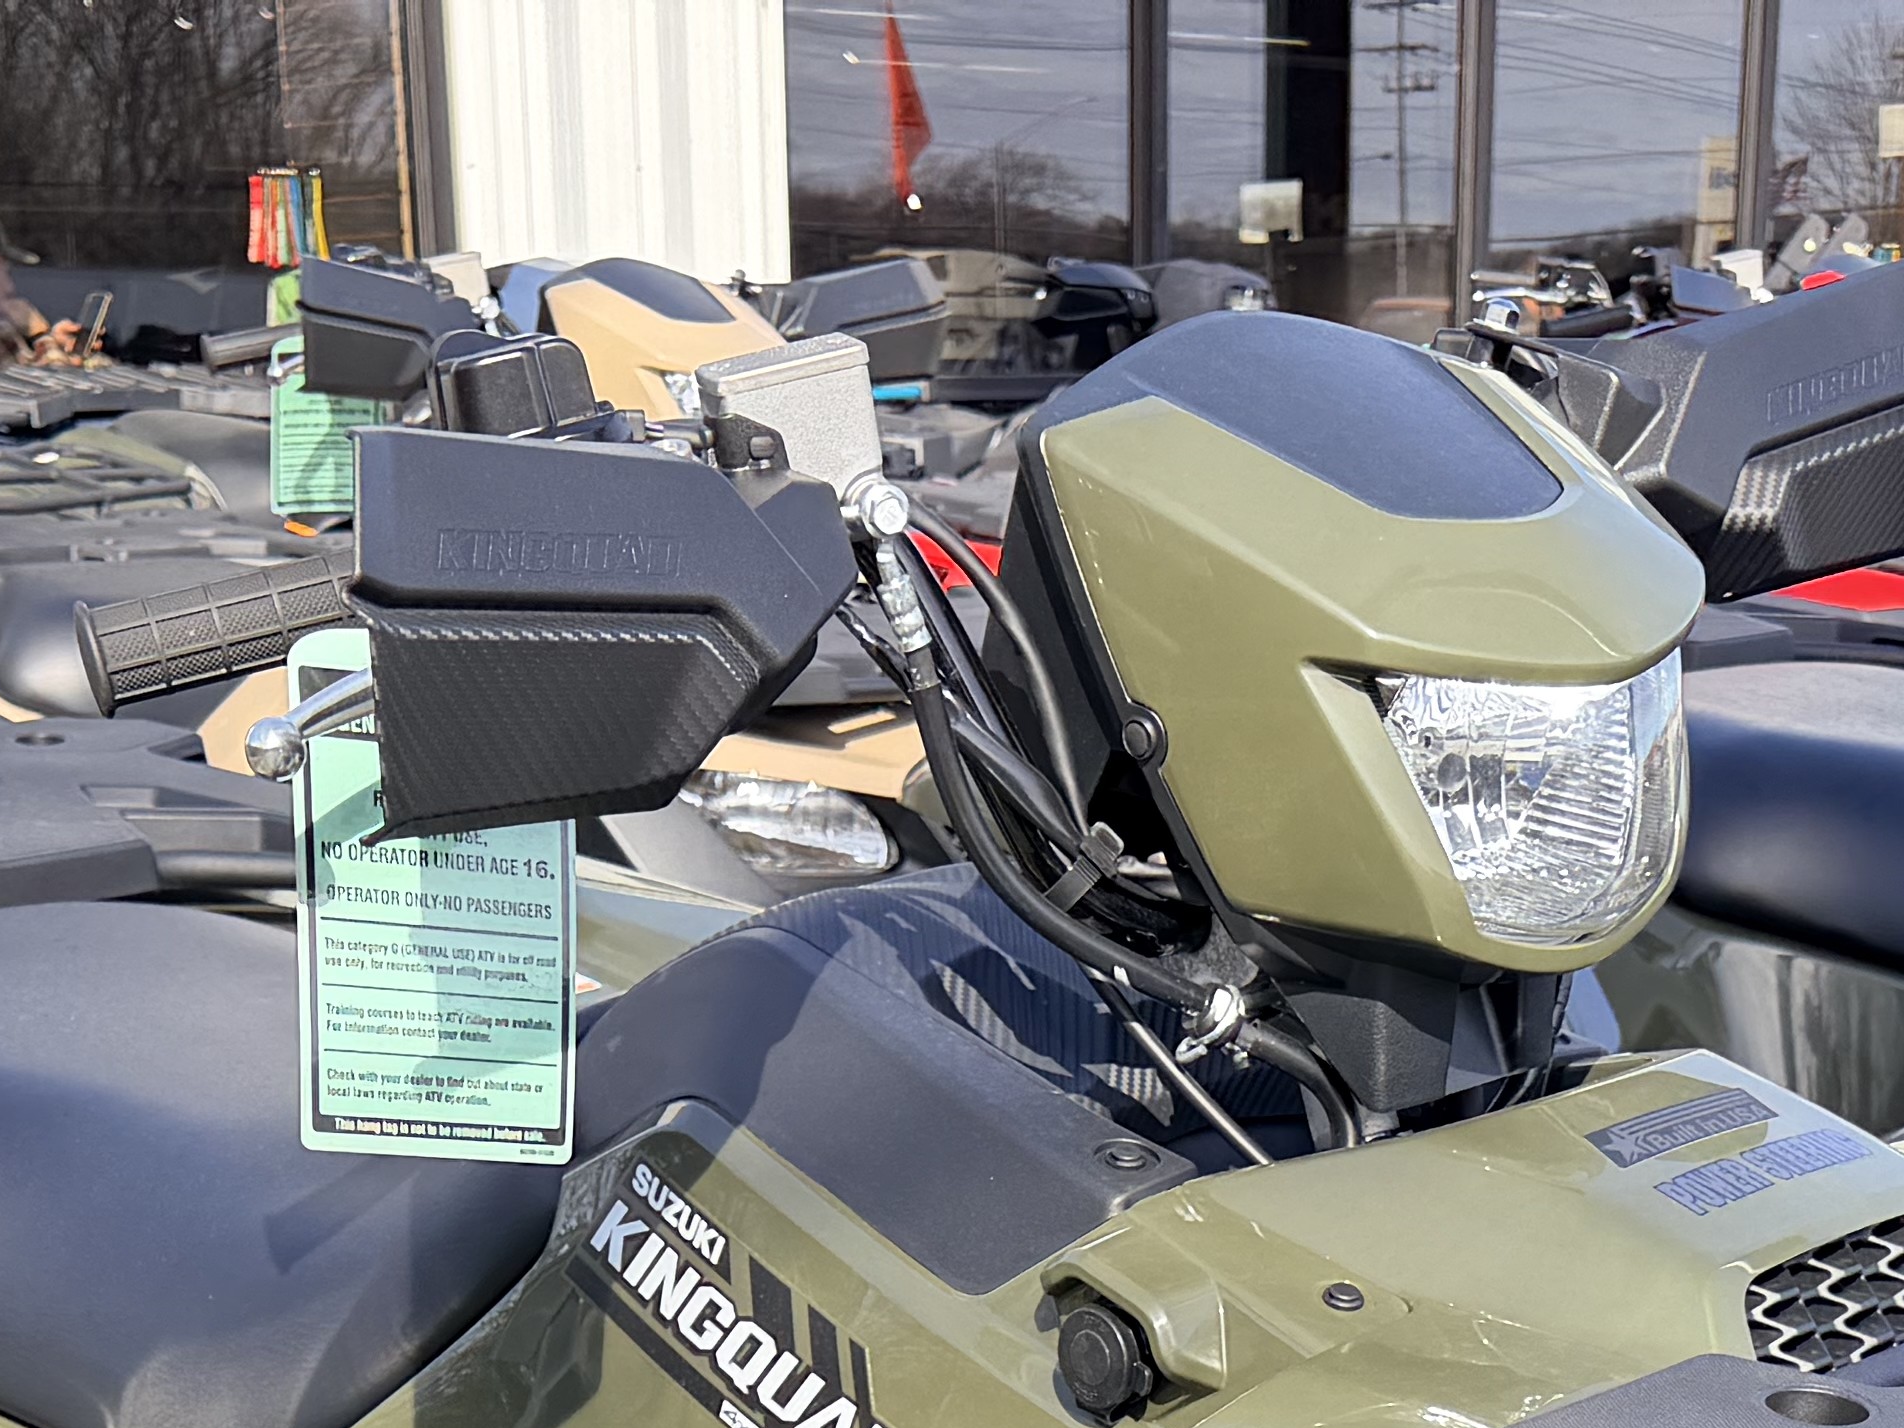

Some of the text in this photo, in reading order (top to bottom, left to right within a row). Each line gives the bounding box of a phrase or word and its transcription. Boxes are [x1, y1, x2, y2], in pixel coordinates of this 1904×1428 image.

[322, 841, 555, 880] NO OPERATOR UNDER AGE 16.
[327, 884, 400, 905] OPERATOR
[466, 896, 552, 920] PASSENGERS
[325, 937, 344, 950] This
[348, 940, 387, 955] category
[478, 949, 495, 961] ATV
[325, 957, 341, 966] use
[371, 959, 383, 970] for
[387, 961, 434, 974] recreation
[326, 1003, 364, 1019] Training
[367, 1009, 404, 1021] courses
[406, 1010, 415, 1021] to
[418, 1011, 443, 1023] teach
[446, 1012, 463, 1024] ATV
[326, 1021, 341, 1032] For
[402, 1025, 435, 1039] contact
[327, 1068, 355, 1082] Check
[358, 1070, 378, 1083] with
[381, 1073, 401, 1085] your
[403, 1074, 433, 1086] dealer
[467, 1078, 481, 1090] out
[484, 1078, 509, 1091] about
[511, 1080, 531, 1092] state
[327, 1085, 350, 1097] local
[353, 1087, 375, 1099] laws
[378, 1089, 422, 1104] regarding
[425, 1090, 442, 1103] ATV
[335, 1117, 355, 1131] This
[1651, 1121, 1700, 1150] Built
[1724, 1102, 1772, 1128] USA
[1653, 1157, 1776, 1216] POWER
[1739, 1128, 1874, 1181] STEERING
[631, 1163, 727, 1266] SUZUKI
